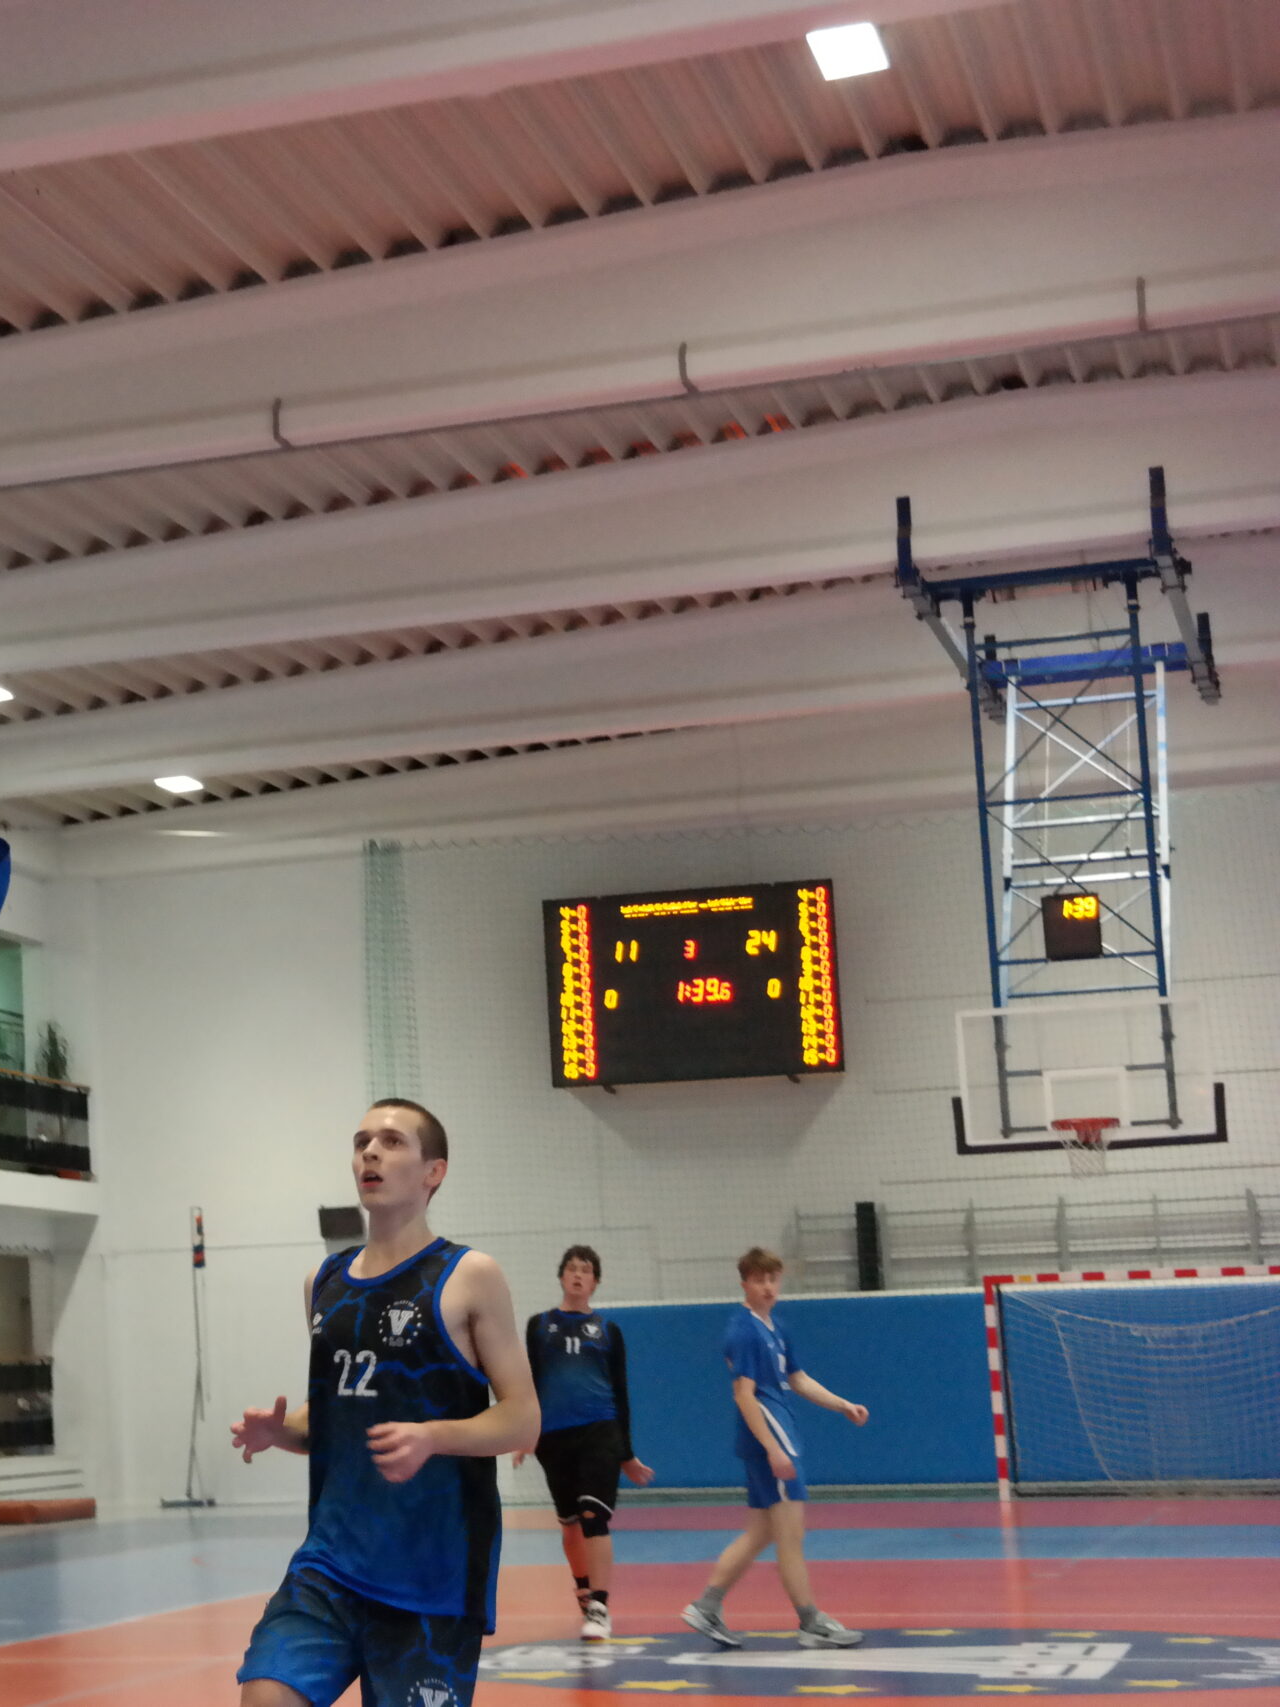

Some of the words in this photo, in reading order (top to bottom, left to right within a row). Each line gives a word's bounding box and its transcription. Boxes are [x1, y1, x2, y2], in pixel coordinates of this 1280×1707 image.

[1063, 896, 1097, 919] 1:39
[615, 941, 638, 962] 11
[683, 940, 697, 960] 3
[746, 930, 776, 955] 24
[604, 989, 618, 1009] 0
[767, 978, 781, 999] 0
[565, 1335, 581, 1354] 11
[333, 1349, 379, 1397] 22
